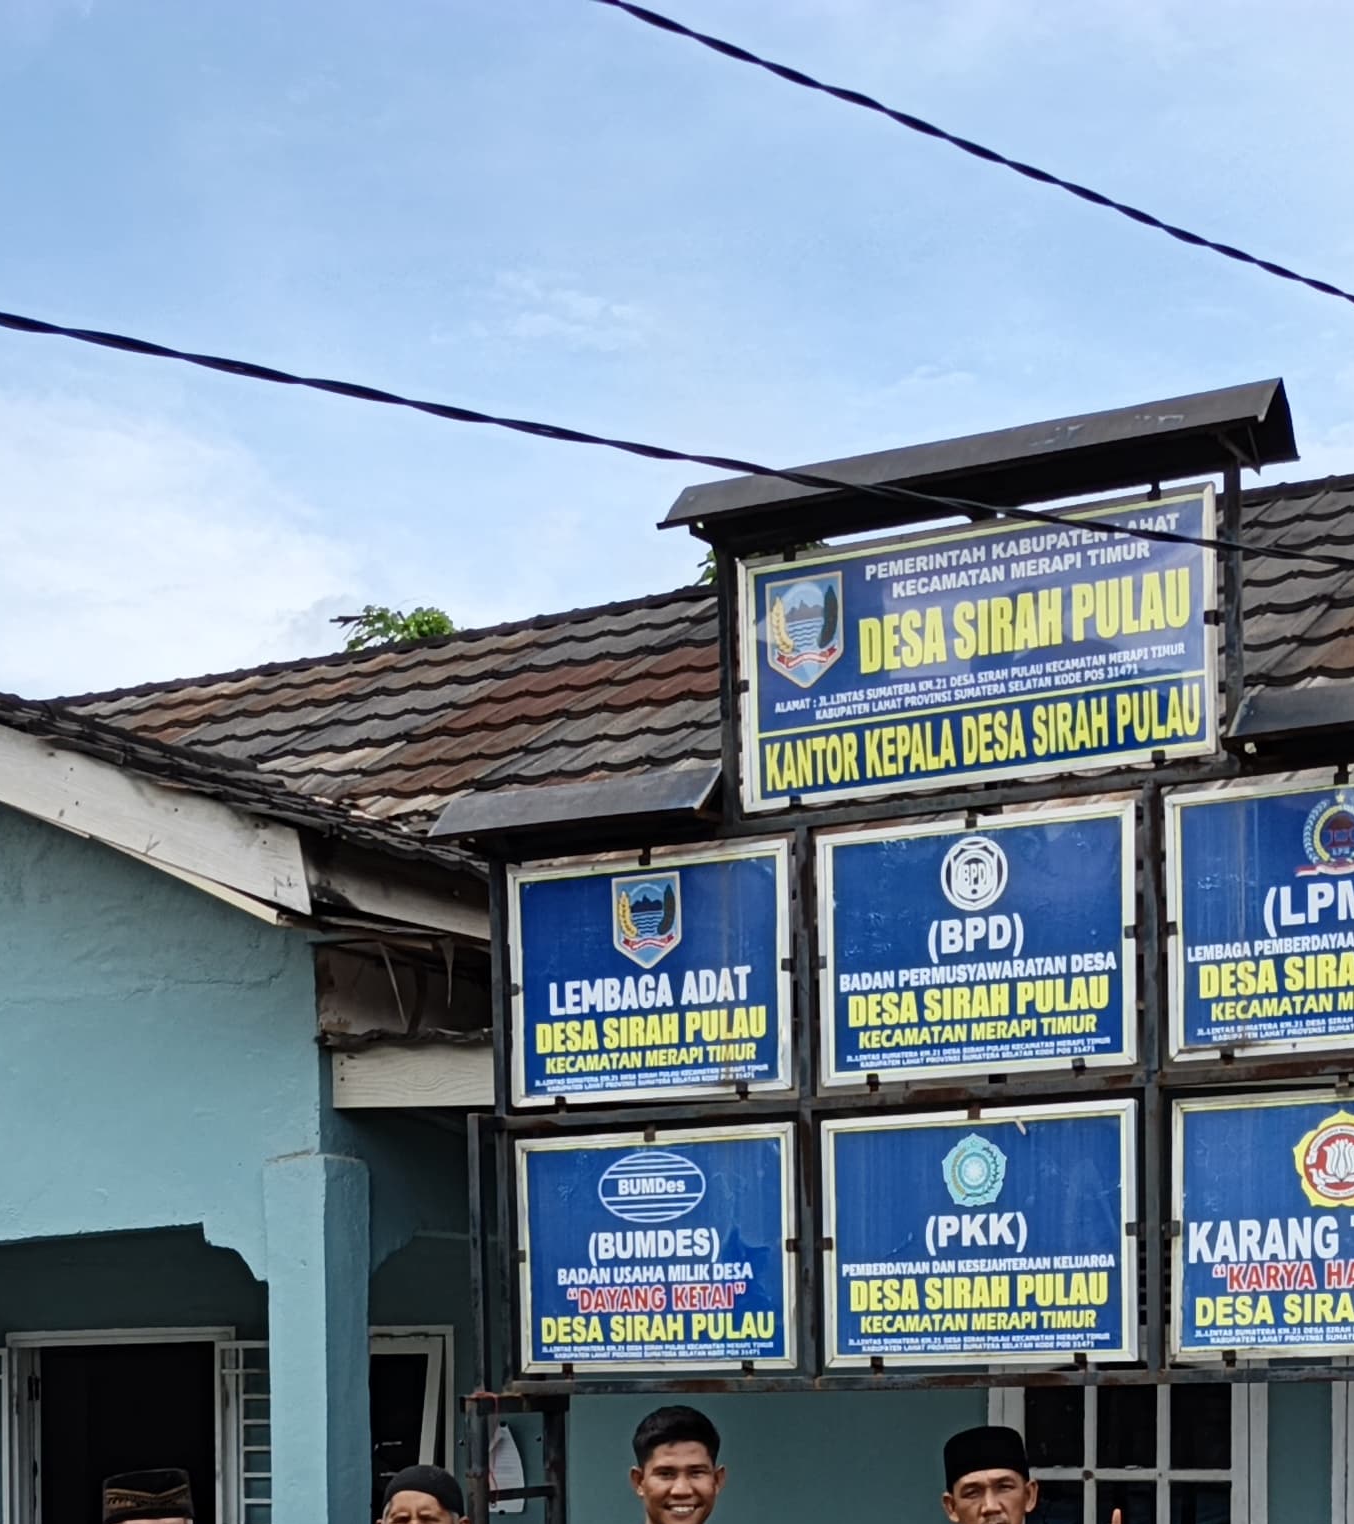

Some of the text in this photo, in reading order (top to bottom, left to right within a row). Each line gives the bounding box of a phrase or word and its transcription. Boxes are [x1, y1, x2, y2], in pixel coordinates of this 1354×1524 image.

[865, 546, 986, 580] PEMERINTAH
[992, 525, 1108, 559] KABUPATEN
[892, 541, 1150, 598] KECAMATAN MERAPI TIMUR
[859, 567, 1190, 674] DESA SIRAH PULAU
[775, 699, 811, 713] ALAMAT
[866, 683, 917, 703] SUMATERA
[919, 678, 947, 692] KM.21
[950, 674, 975, 687] DESA
[977, 671, 1009, 684] SIRAH
[1010, 664, 1044, 678] PULAU
[1045, 653, 1107, 673] KECAMATAN
[1108, 647, 1148, 664] MERAPI
[1151, 642, 1186, 658] TIMUR
[815, 663, 1139, 720] KABUPATEN LAHAT PROVINSI SUMATERA SELATAN KODE POS 31471
[765, 683, 1201, 792] KANTOR KEPALA DESA SIRAH PULAU
[928, 912, 1024, 964] (BPD)
[1187, 940, 1251, 963] LEMBAGA
[549, 965, 752, 1016] LEMBAGA ADAT
[839, 952, 1117, 993] BADAN PERMUSYAWARATAN DESA
[535, 1005, 767, 1055] DESA SIRAH PULAU
[618, 1177, 686, 1196] BUMDes
[588, 1227, 721, 1265] (BUMDES)
[925, 1211, 1028, 1256] (PKK)
[1188, 1215, 1341, 1264] KARANG
[557, 1262, 754, 1286] BADAN USAHA MILIK DESA
[841, 1254, 1115, 1277] PEMBERDAYAAN DAN KESEJAHTERAAN KELUARGA
[541, 1311, 775, 1344] DESA SIRAH PULAU
[1195, 1295, 1274, 1327] DESA
